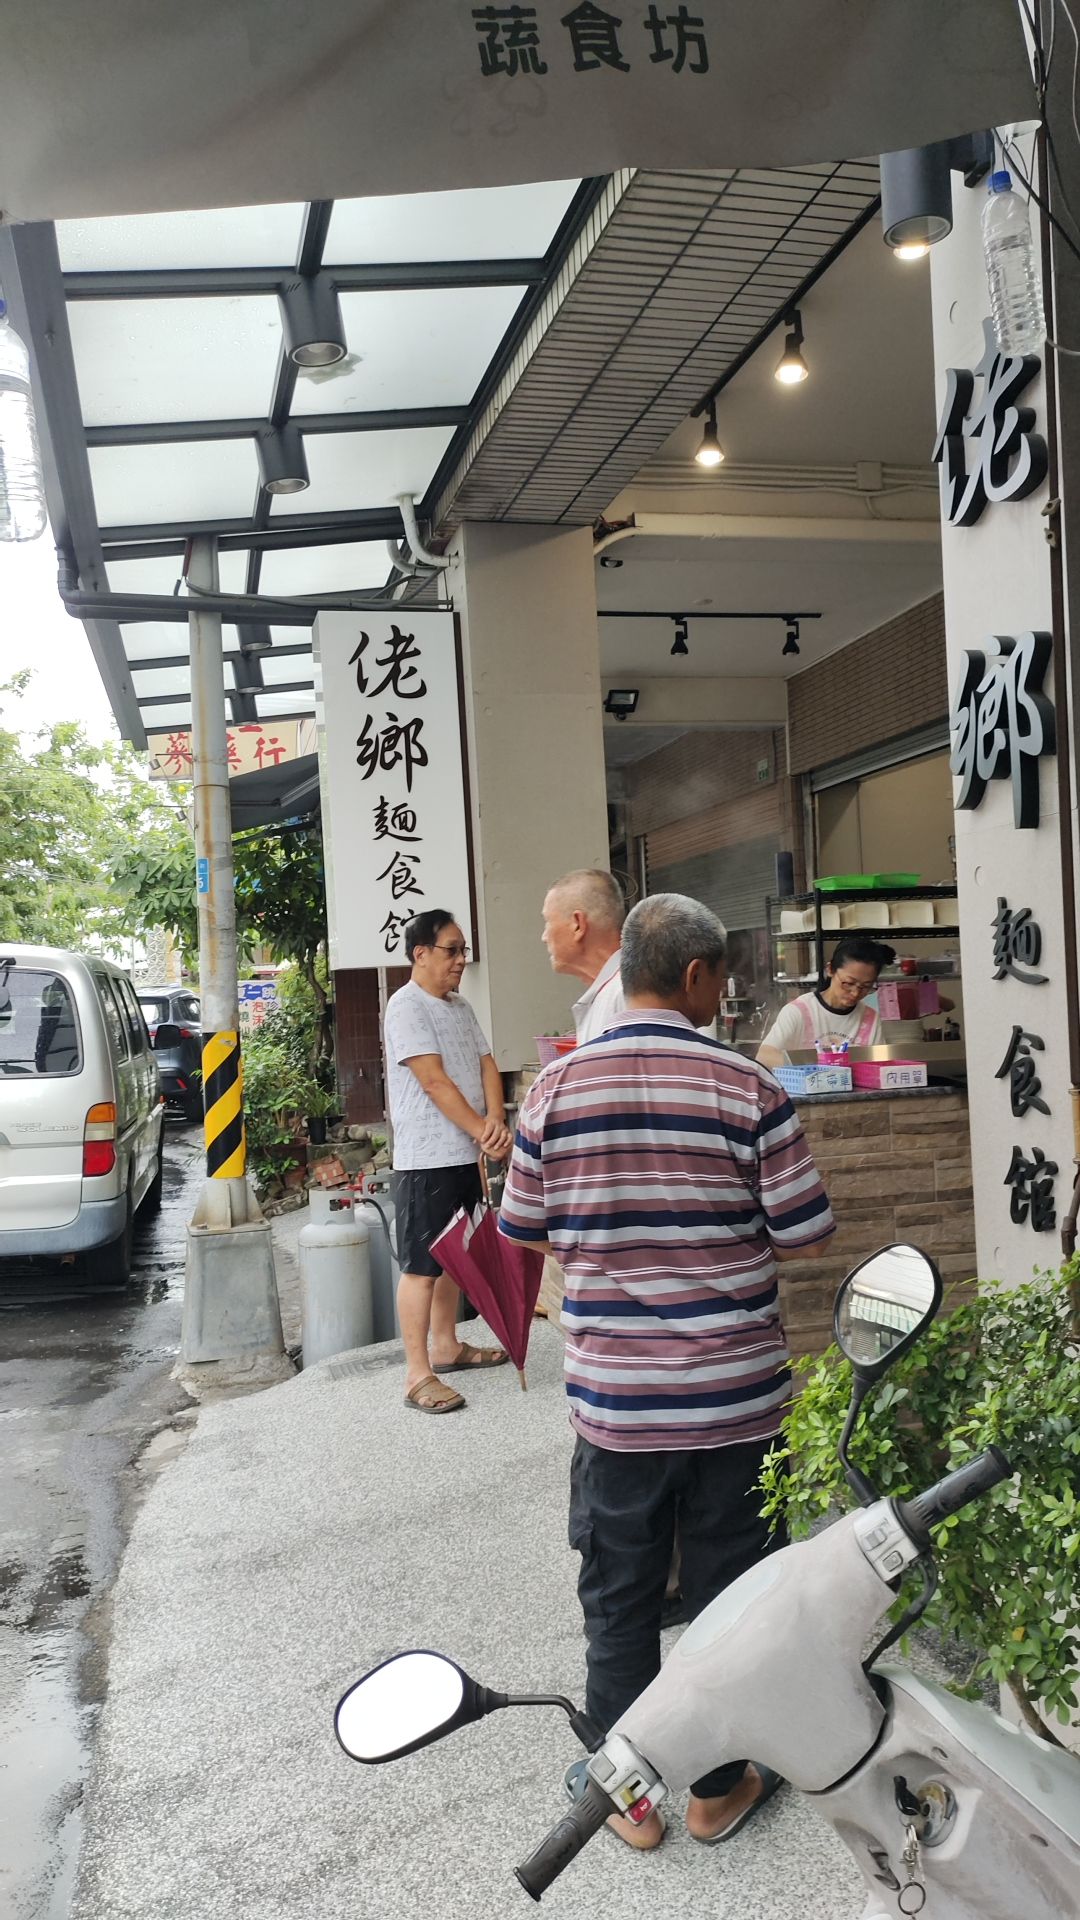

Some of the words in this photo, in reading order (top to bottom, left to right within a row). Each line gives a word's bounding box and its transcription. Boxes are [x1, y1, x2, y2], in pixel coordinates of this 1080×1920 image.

[471, 1, 710, 77] 蔬食坊
[931, 316, 1059, 1233] 佬鄉麵食館
